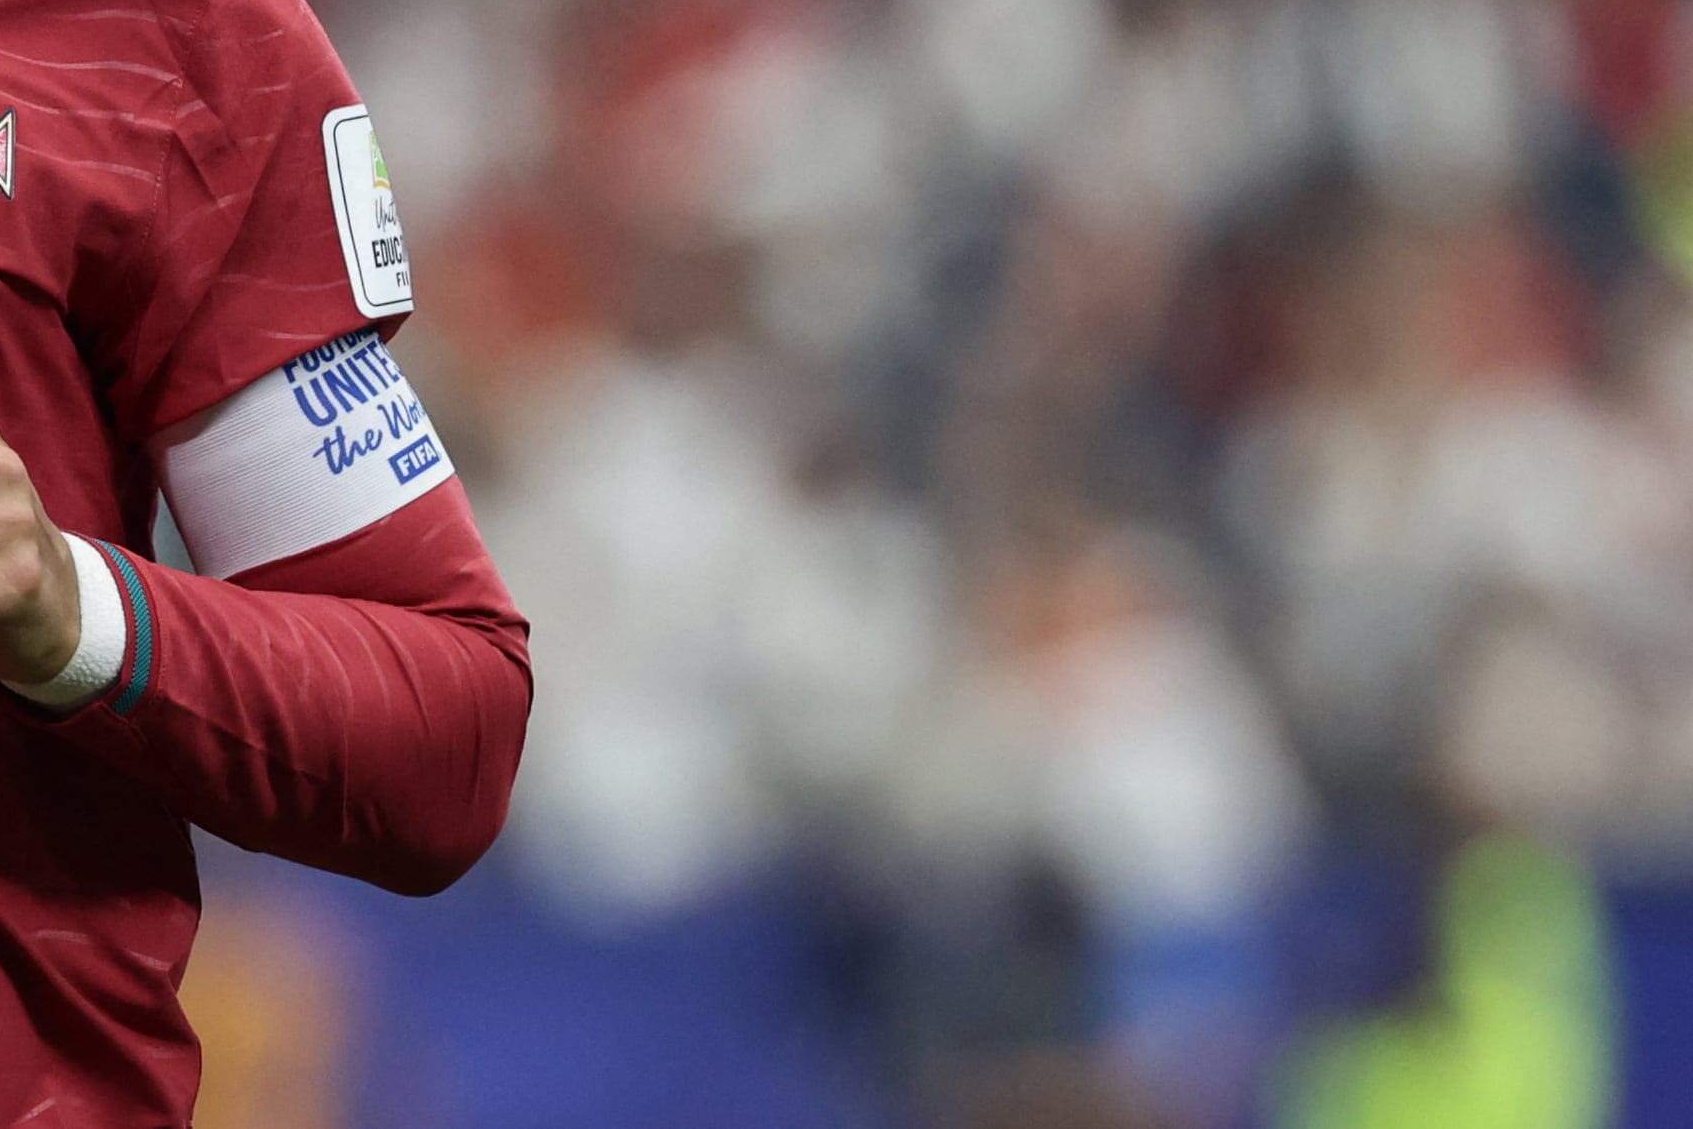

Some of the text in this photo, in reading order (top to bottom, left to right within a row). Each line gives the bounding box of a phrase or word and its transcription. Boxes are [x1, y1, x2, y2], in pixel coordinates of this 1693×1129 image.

[293, 337, 403, 427] UNITE
[313, 426, 383, 475] the
[396, 442, 437, 477] FIFA
